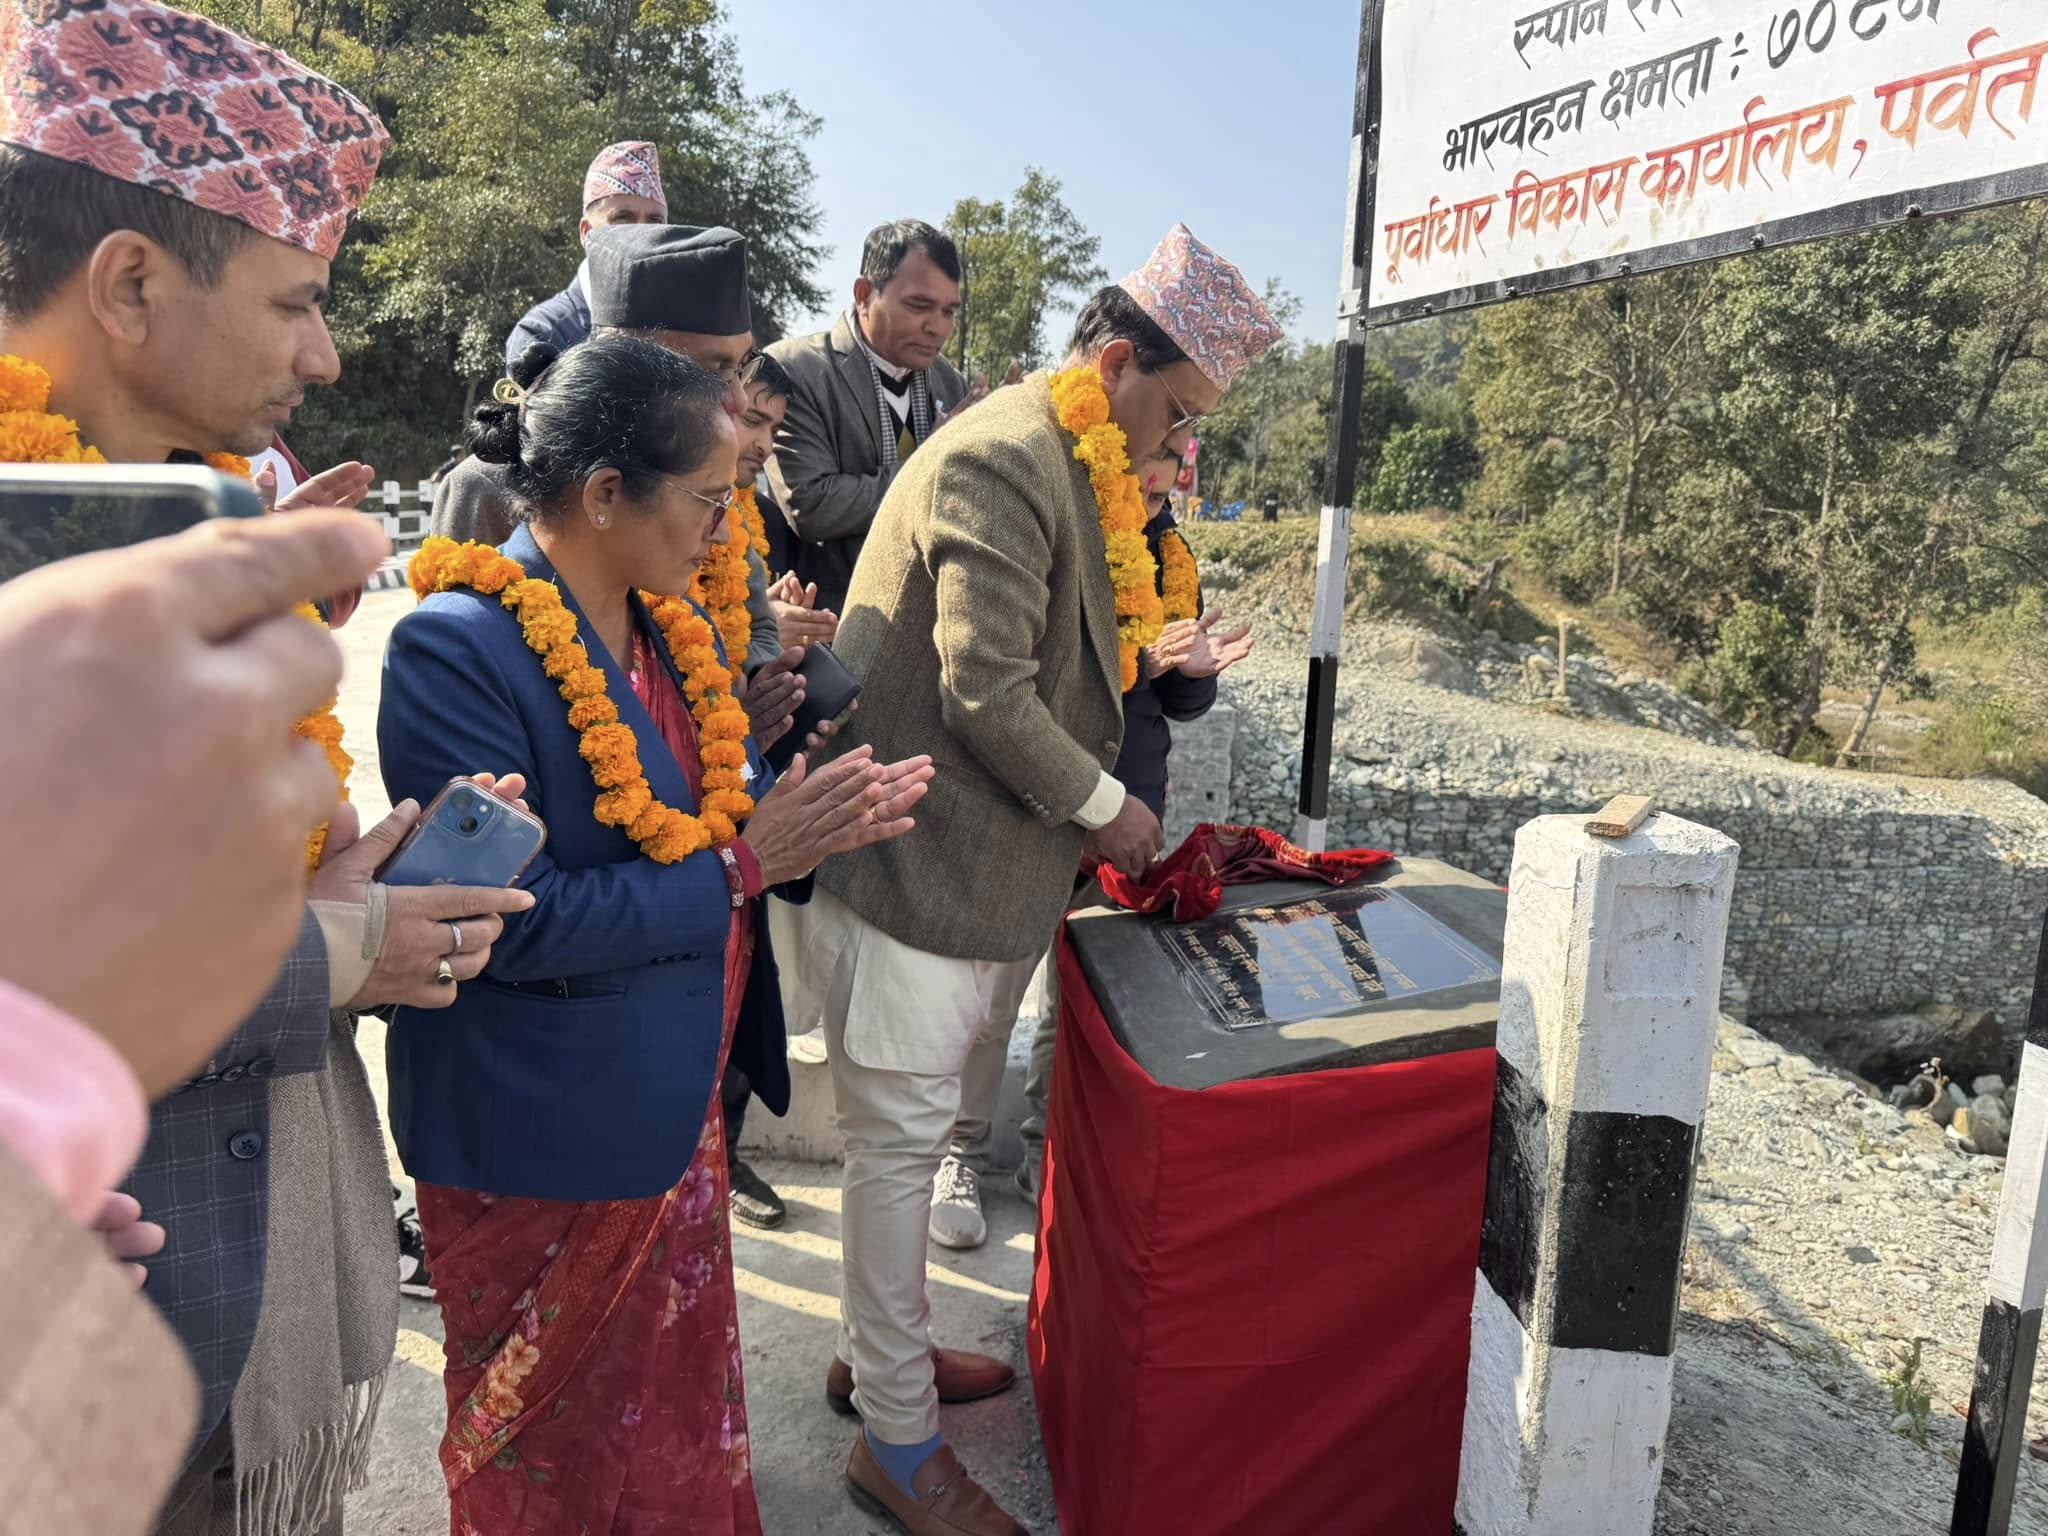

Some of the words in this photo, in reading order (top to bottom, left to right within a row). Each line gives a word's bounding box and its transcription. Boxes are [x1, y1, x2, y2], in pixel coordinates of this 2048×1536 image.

[1384, 195, 1501, 285] पूर्वाधार
[1505, 155, 1641, 242] विकास
[1639, 94, 1868, 209] कार्यालय,
[1874, 26, 2048, 151] पर्वत
[1443, 79, 1598, 173] भारवहन
